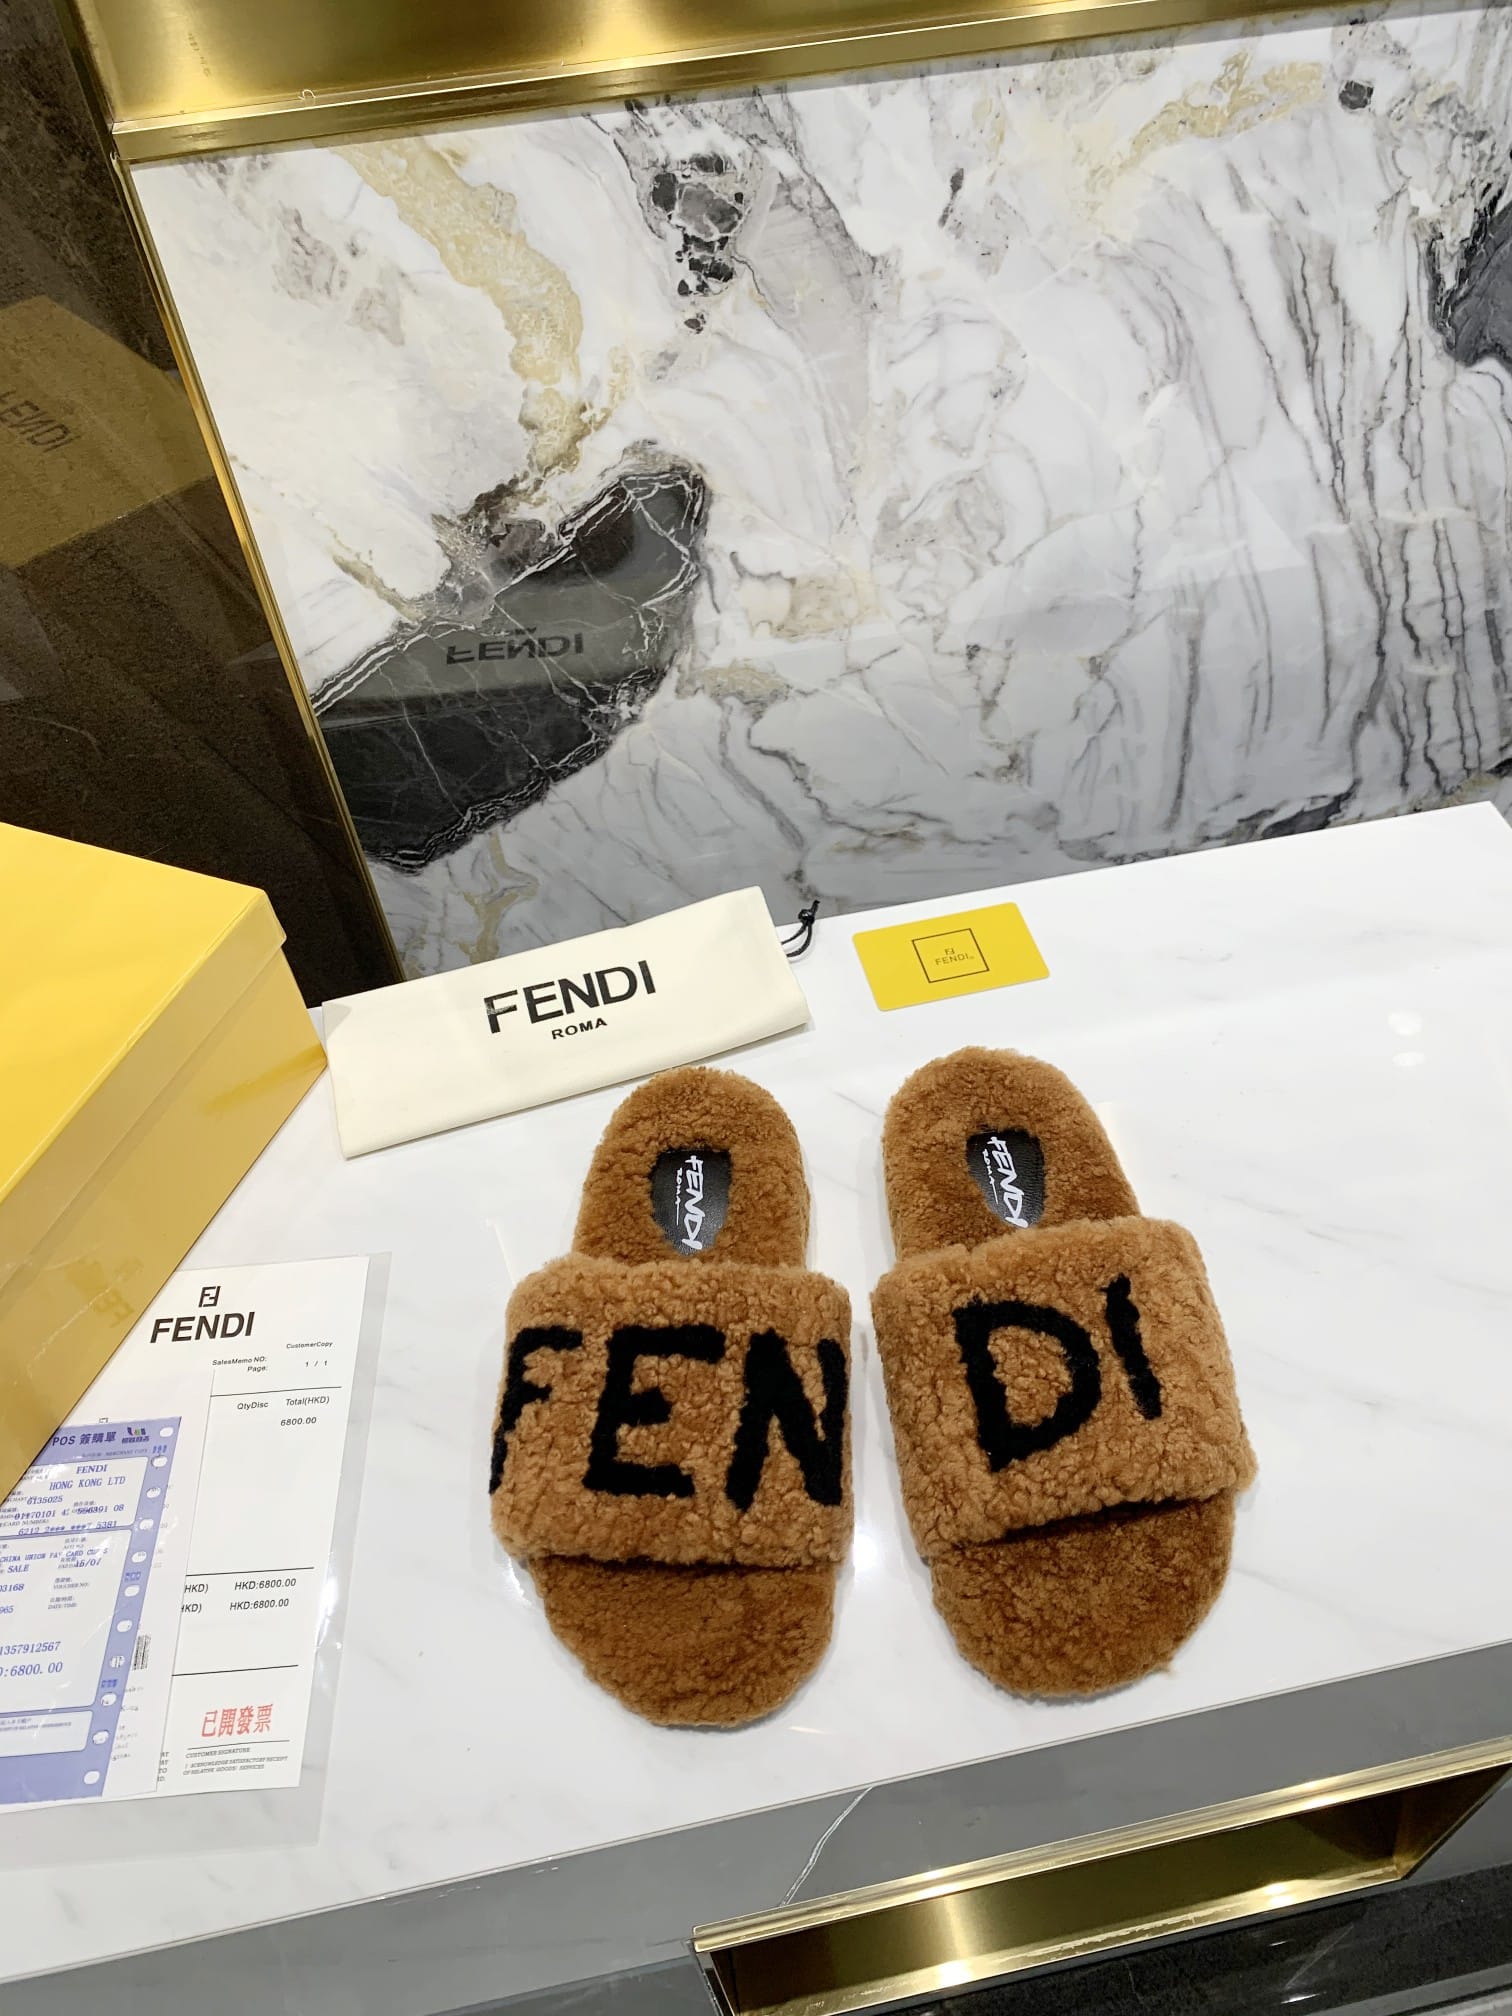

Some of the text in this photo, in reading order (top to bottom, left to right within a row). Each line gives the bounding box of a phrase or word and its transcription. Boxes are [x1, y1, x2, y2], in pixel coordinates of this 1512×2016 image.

[935, 953, 969, 965] FENDI
[484, 960, 656, 1034] FENDI
[551, 1017, 608, 1040] ROMA
[987, 1136, 1028, 1229] FENDI
[682, 1155, 706, 1250] FENDI
[150, 1311, 256, 1343] FENDI
[952, 1272, 1164, 1473] DI
[285, 1396, 330, 1407] Total(HKD)
[280, 1417, 317, 1427] 6800.00
[490, 1324, 849, 1512] FEN
[52, 1435, 76, 1447] POS
[76, 1464, 108, 1475] FENDI
[49, 1476, 126, 1491] HONG KONG LTD
[7, 1564, 30, 1573] SALE
[234, 1578, 297, 1590] HKD:6800.00
[229, 1598, 289, 1611] HKD:6800.00
[201, 1703, 273, 1738] 已開發票
